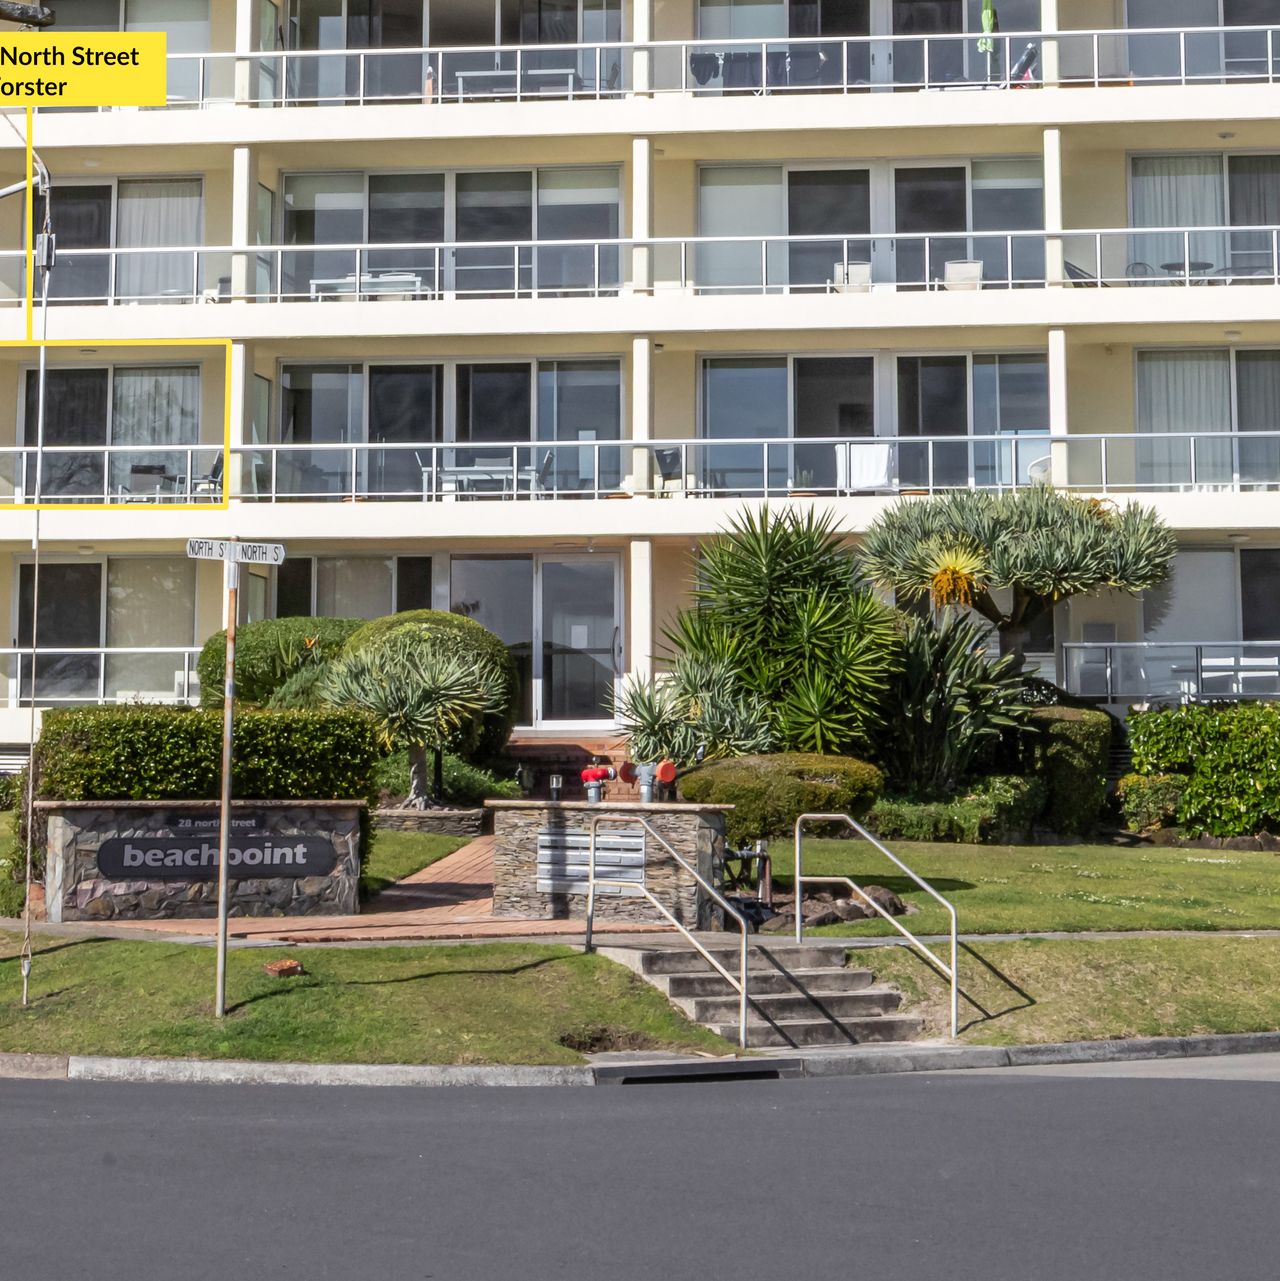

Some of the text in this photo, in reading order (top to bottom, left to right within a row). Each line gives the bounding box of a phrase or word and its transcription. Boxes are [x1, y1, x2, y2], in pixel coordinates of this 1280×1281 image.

[189, 540, 213, 557] NORTH
[241, 544, 267, 561] NORTH
[178, 818, 192, 828] 28
[229, 818, 256, 828] treet
